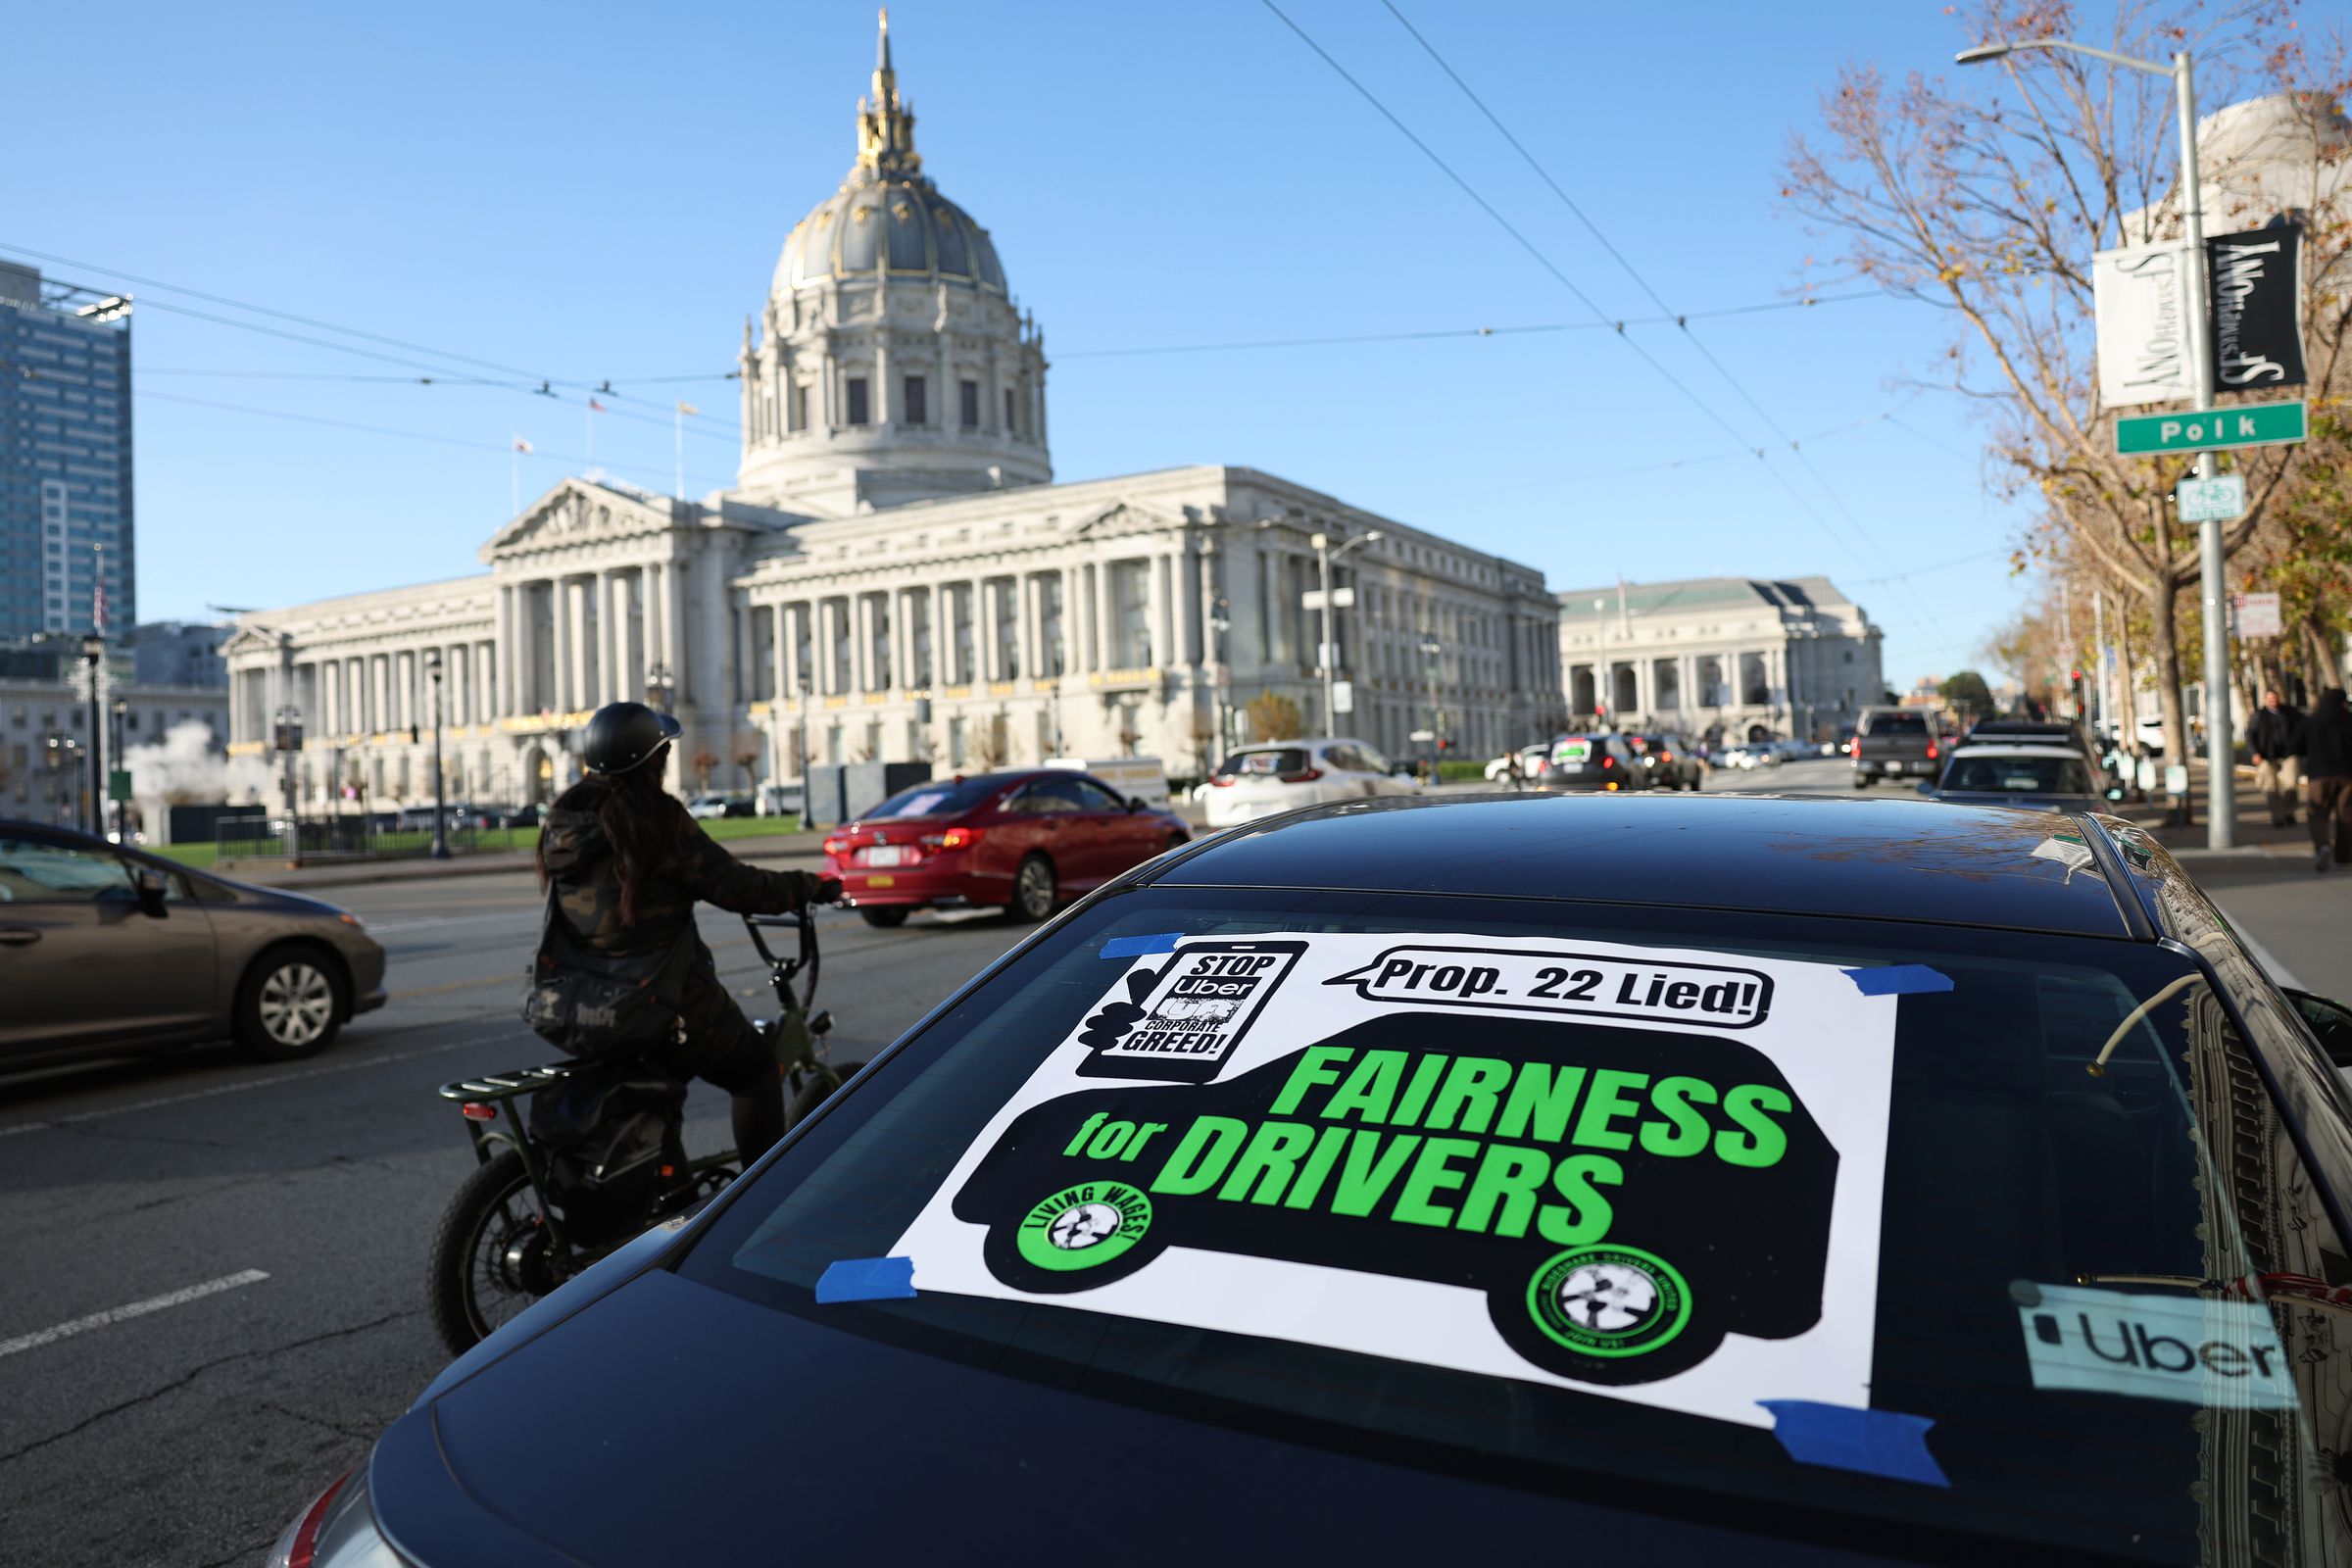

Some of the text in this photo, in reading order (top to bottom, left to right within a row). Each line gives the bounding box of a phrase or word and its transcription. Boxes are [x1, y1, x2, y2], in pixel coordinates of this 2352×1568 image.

[2160, 415, 2257, 443] Polk
[1190, 956, 1277, 976] STOP
[1373, 958, 1760, 1016] Prop. 22 Lied!
[1174, 978, 1255, 997] Uber
[1123, 1032, 1228, 1054] GREED!
[1145, 1020, 1221, 1032] CORPORATE
[1268, 1046, 1792, 1167] FAIRNESS
[1061, 1112, 1624, 1246] for DRIVERS
[1023, 1185, 1149, 1242] LIVING WAGES!
[2077, 1311, 2276, 1378] Uber
